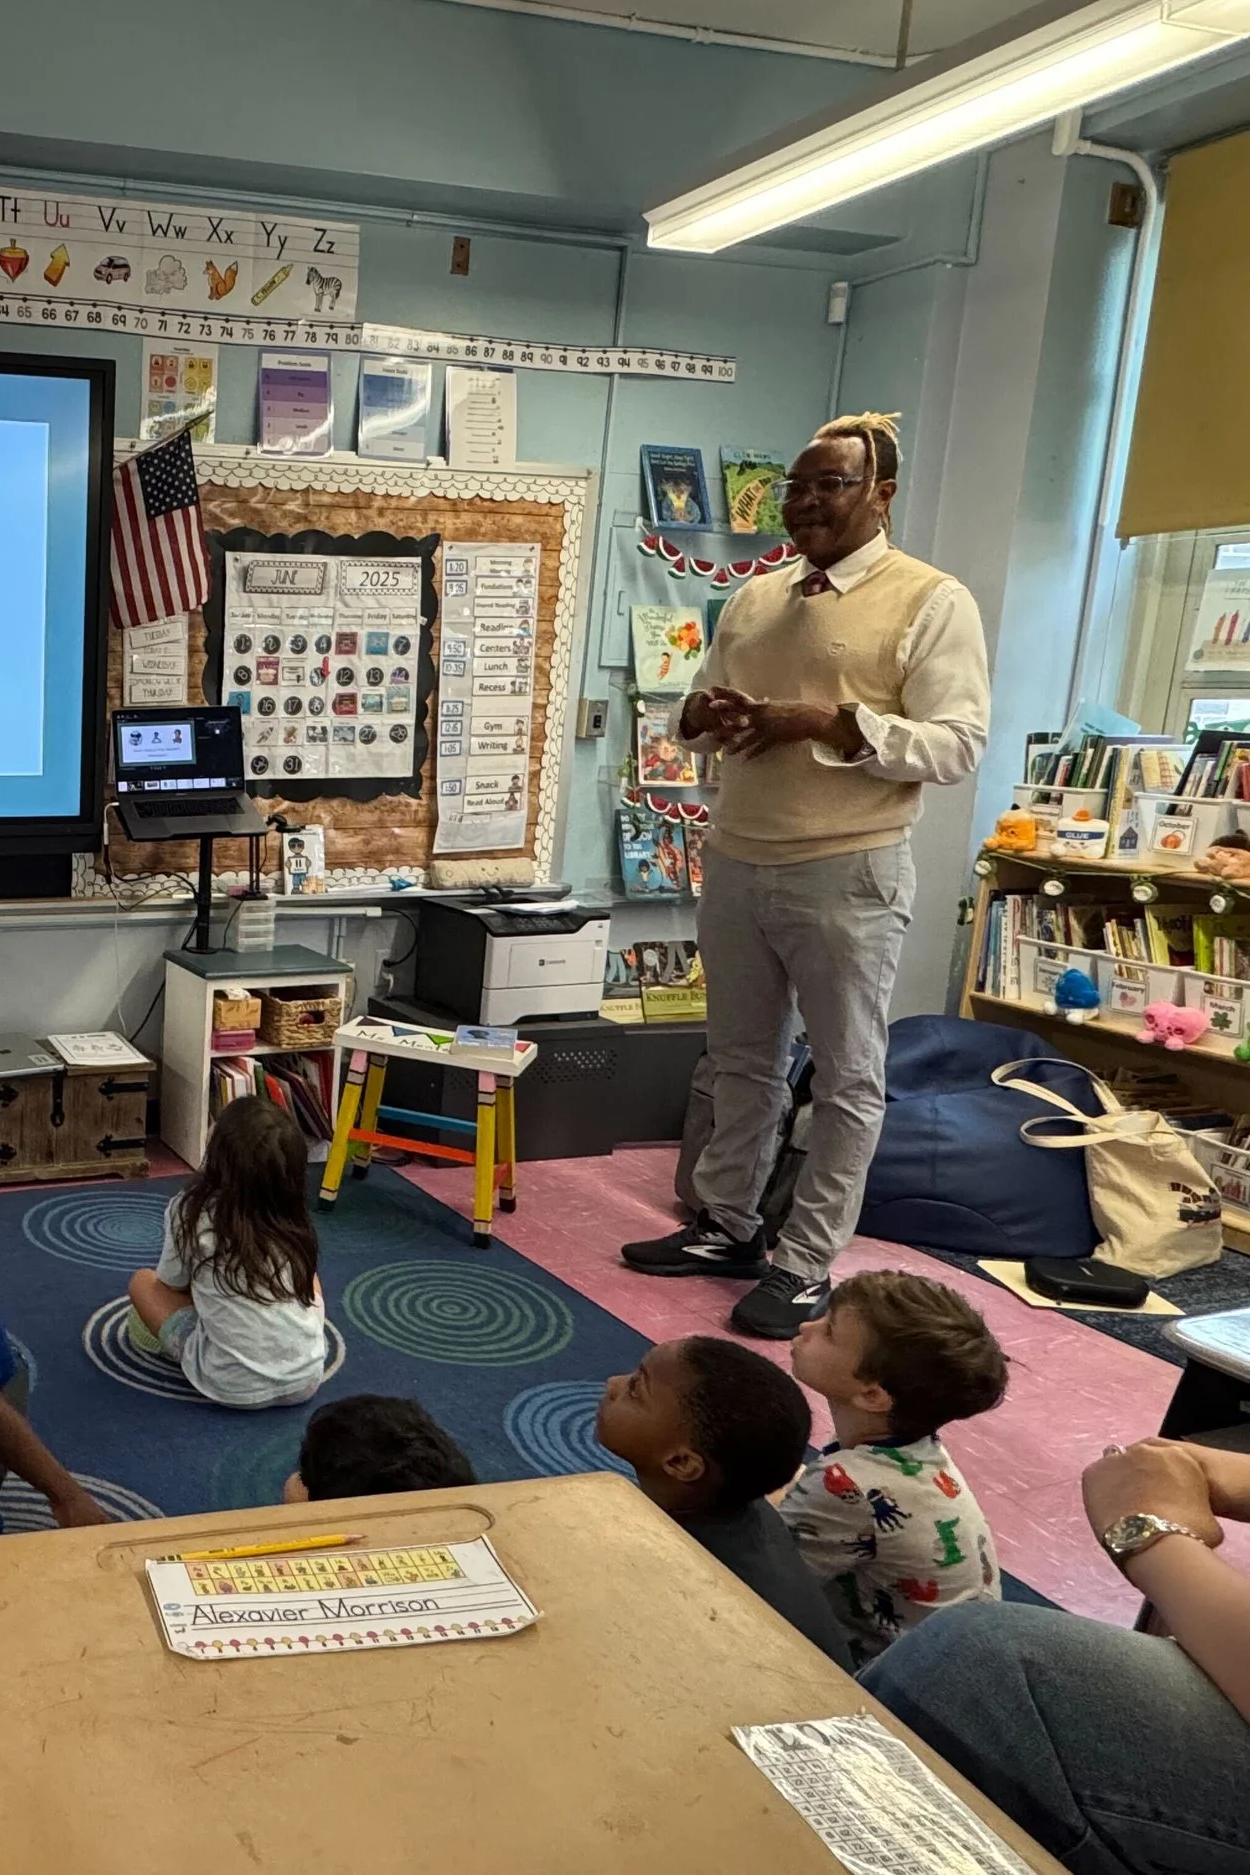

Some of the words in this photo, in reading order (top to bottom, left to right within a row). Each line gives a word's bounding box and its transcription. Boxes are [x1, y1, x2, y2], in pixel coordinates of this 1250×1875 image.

[44, 200, 69, 228] Uu
[97, 207, 126, 233] Vv
[148, 211, 187, 239] Ww
[207, 217, 233, 244] Xx
[261, 222, 288, 259] Yy
[313, 228, 335, 254] Zz
[17, 306, 32, 318] 65
[65, 310, 78, 321] 67
[112, 313, 127, 326] 69
[158, 319, 168, 332] 71
[220, 326, 233, 338] 74
[262, 329, 276, 341] 76
[304, 331, 316, 343] 78
[345, 333, 358, 345] 80
[484, 347, 495, 357] 87
[521, 351, 533, 363] 89
[559, 354, 568, 366] 91
[618, 357, 630, 368] 94
[655, 359, 665, 371] 96
[686, 363, 696, 374] 98
[718, 365, 733, 377] 100
[736, 489, 757, 522] WHAT
[359, 572, 400, 587] 2025
[480, 644, 511, 652] Centers
[484, 662, 508, 670] Lunch
[339, 670, 350, 682] 12
[369, 670, 380, 682] 13
[260, 700, 273, 712] 16
[287, 700, 298, 711] 17
[484, 722, 502, 731] Gym
[478, 742, 507, 750] Writing
[286, 758, 299, 771] 31
[476, 781, 498, 790] Snack
[1158, 821, 1190, 830] October
[1112, 980, 1146, 994] February
[646, 992, 687, 1002] KNUFFLE
[1210, 1001, 1235, 1012] March
[192, 1604, 309, 1626] Alexavier
[318, 1597, 440, 1619] Morrison
